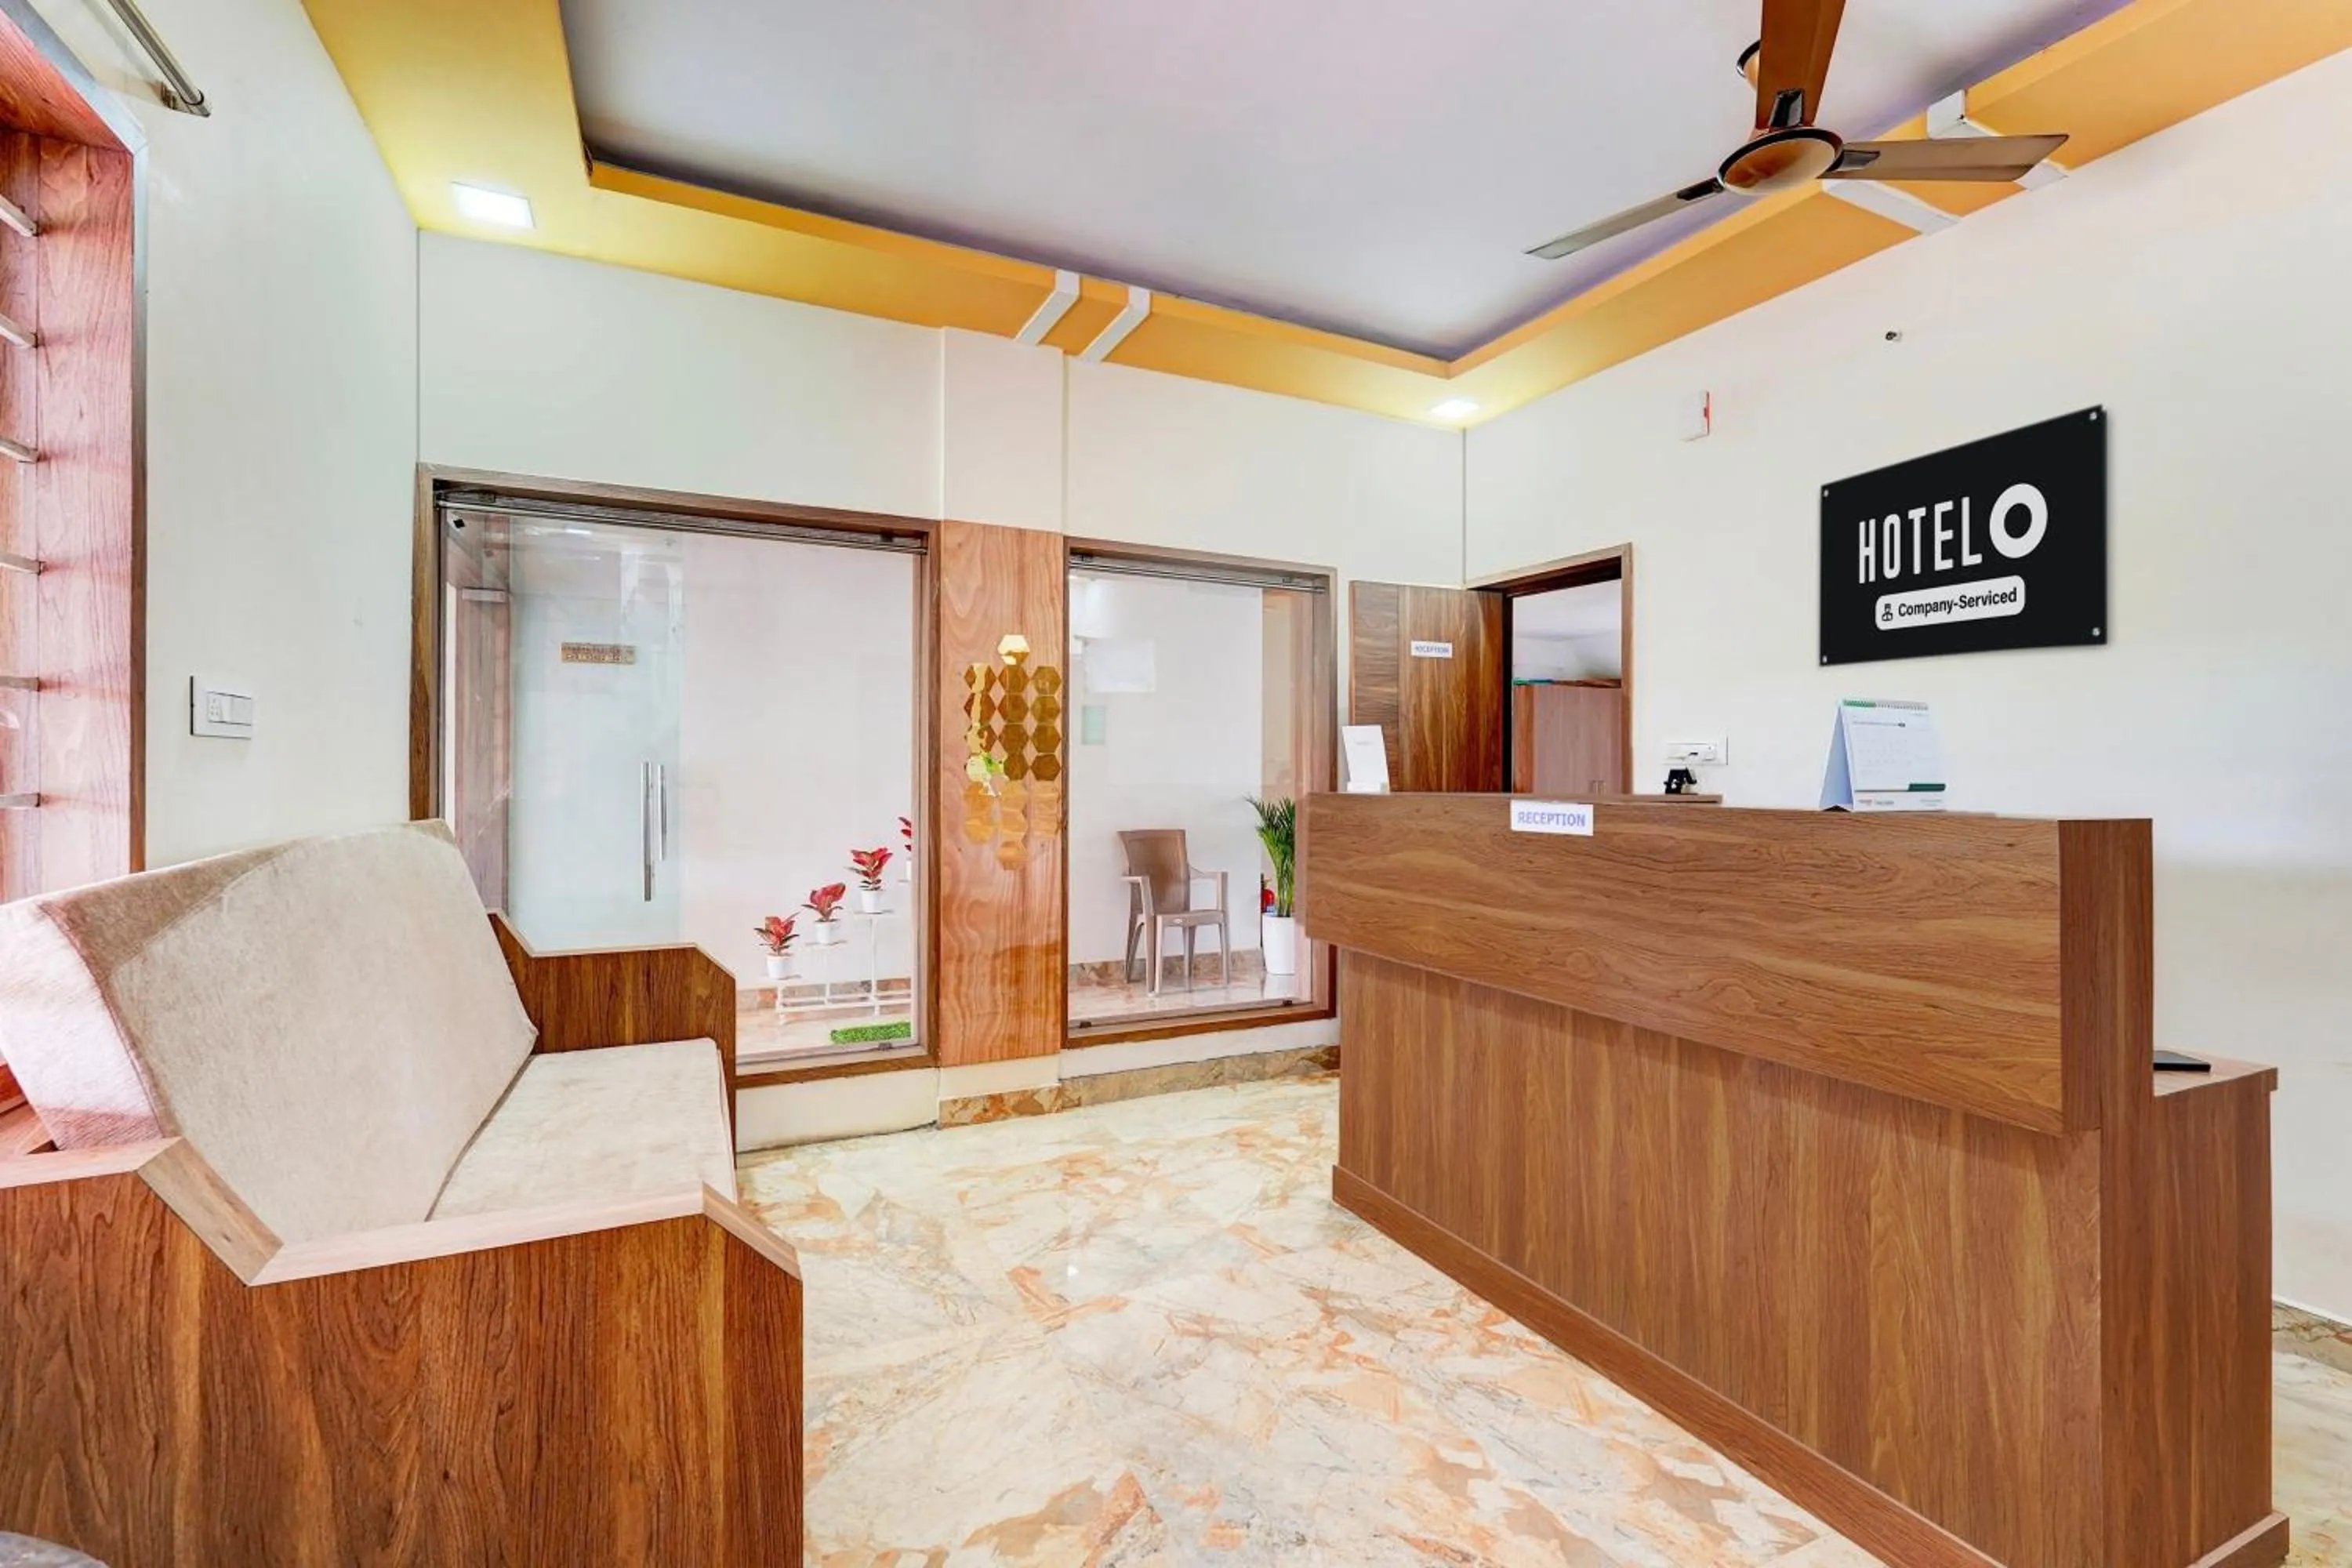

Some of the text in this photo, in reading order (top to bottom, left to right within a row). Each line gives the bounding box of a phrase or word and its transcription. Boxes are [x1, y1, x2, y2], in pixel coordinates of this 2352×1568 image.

[1858, 496, 1983, 584] HOTEL
[1898, 586, 2017, 617] Company-Serviced
[1518, 811, 1586, 827] RECEPTION
